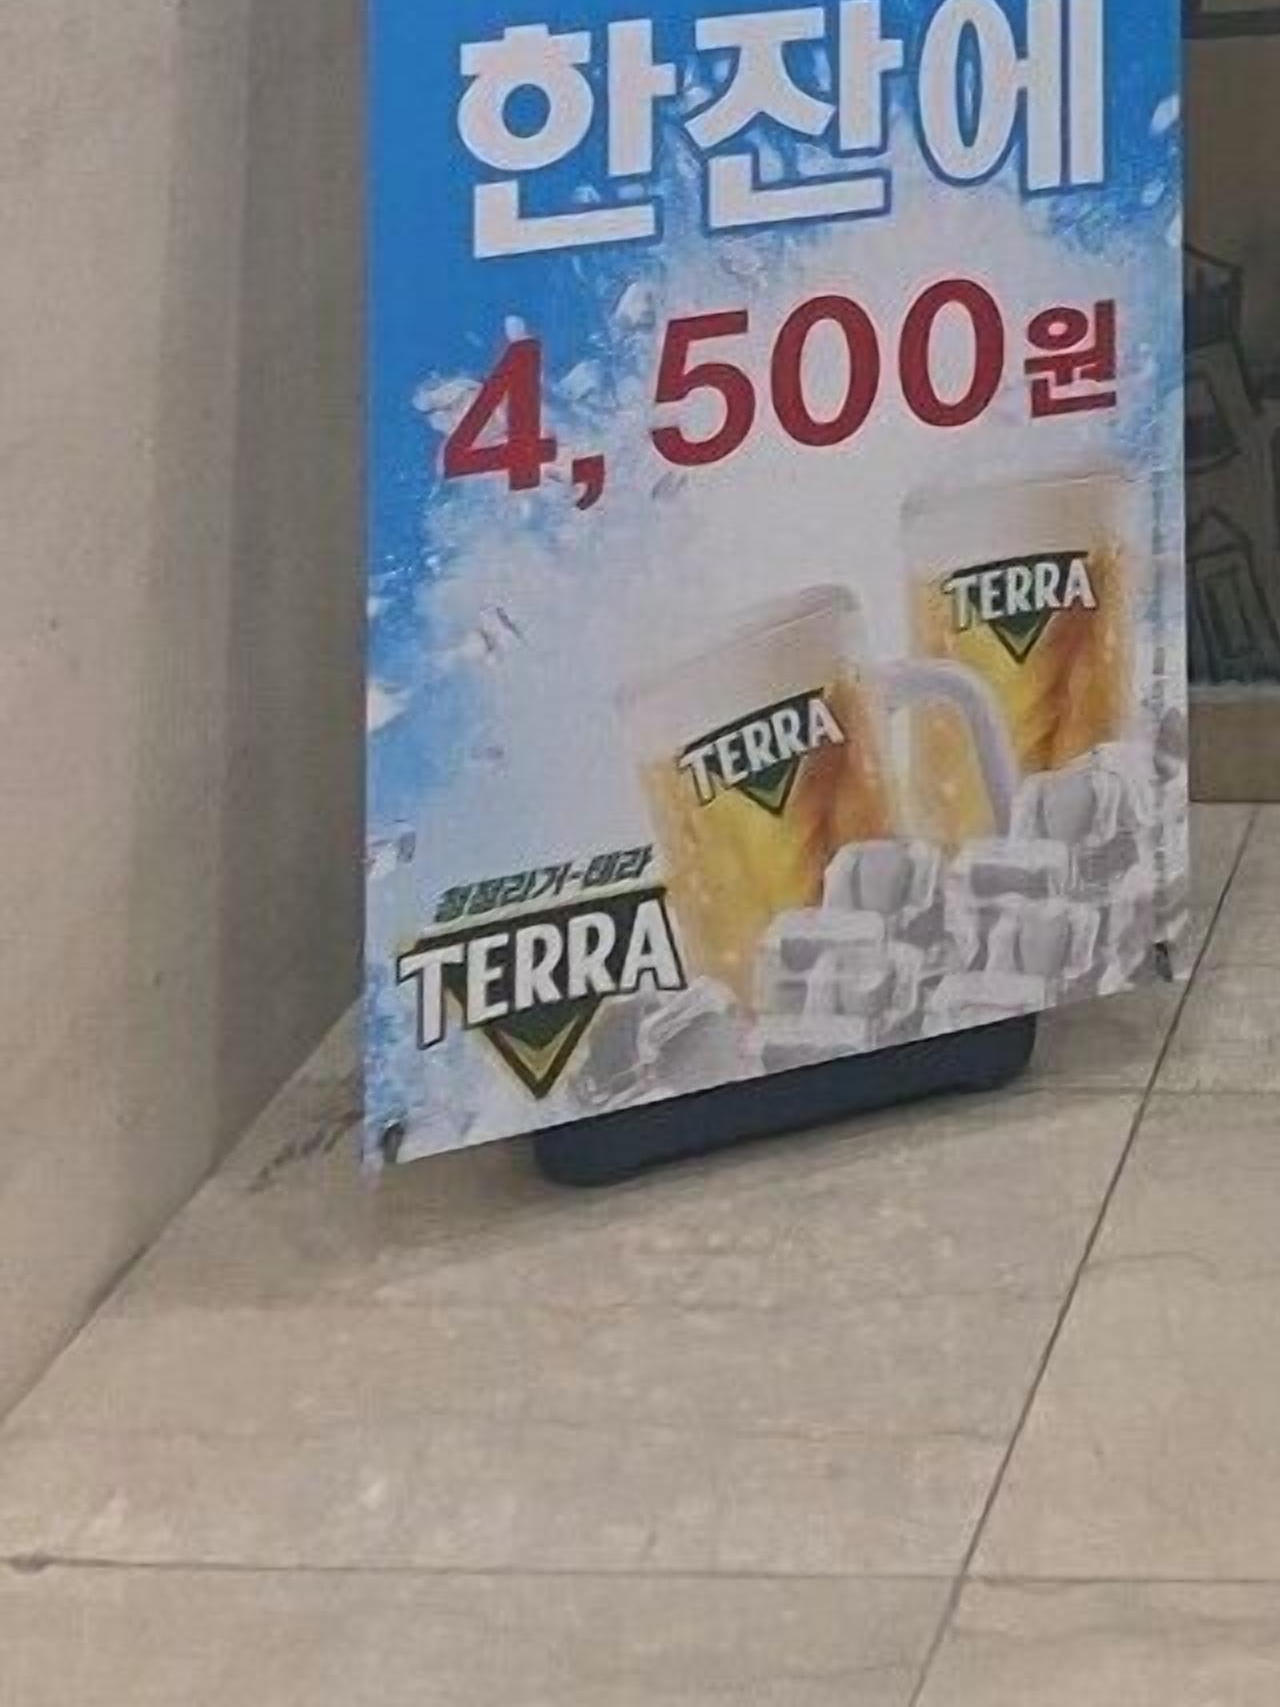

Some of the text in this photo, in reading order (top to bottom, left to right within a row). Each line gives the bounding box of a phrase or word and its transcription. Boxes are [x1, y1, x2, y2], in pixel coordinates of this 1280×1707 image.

[943, 556, 1098, 633] TERRA
[677, 698, 848, 806] TERRA
[397, 897, 689, 1051] TERRA
